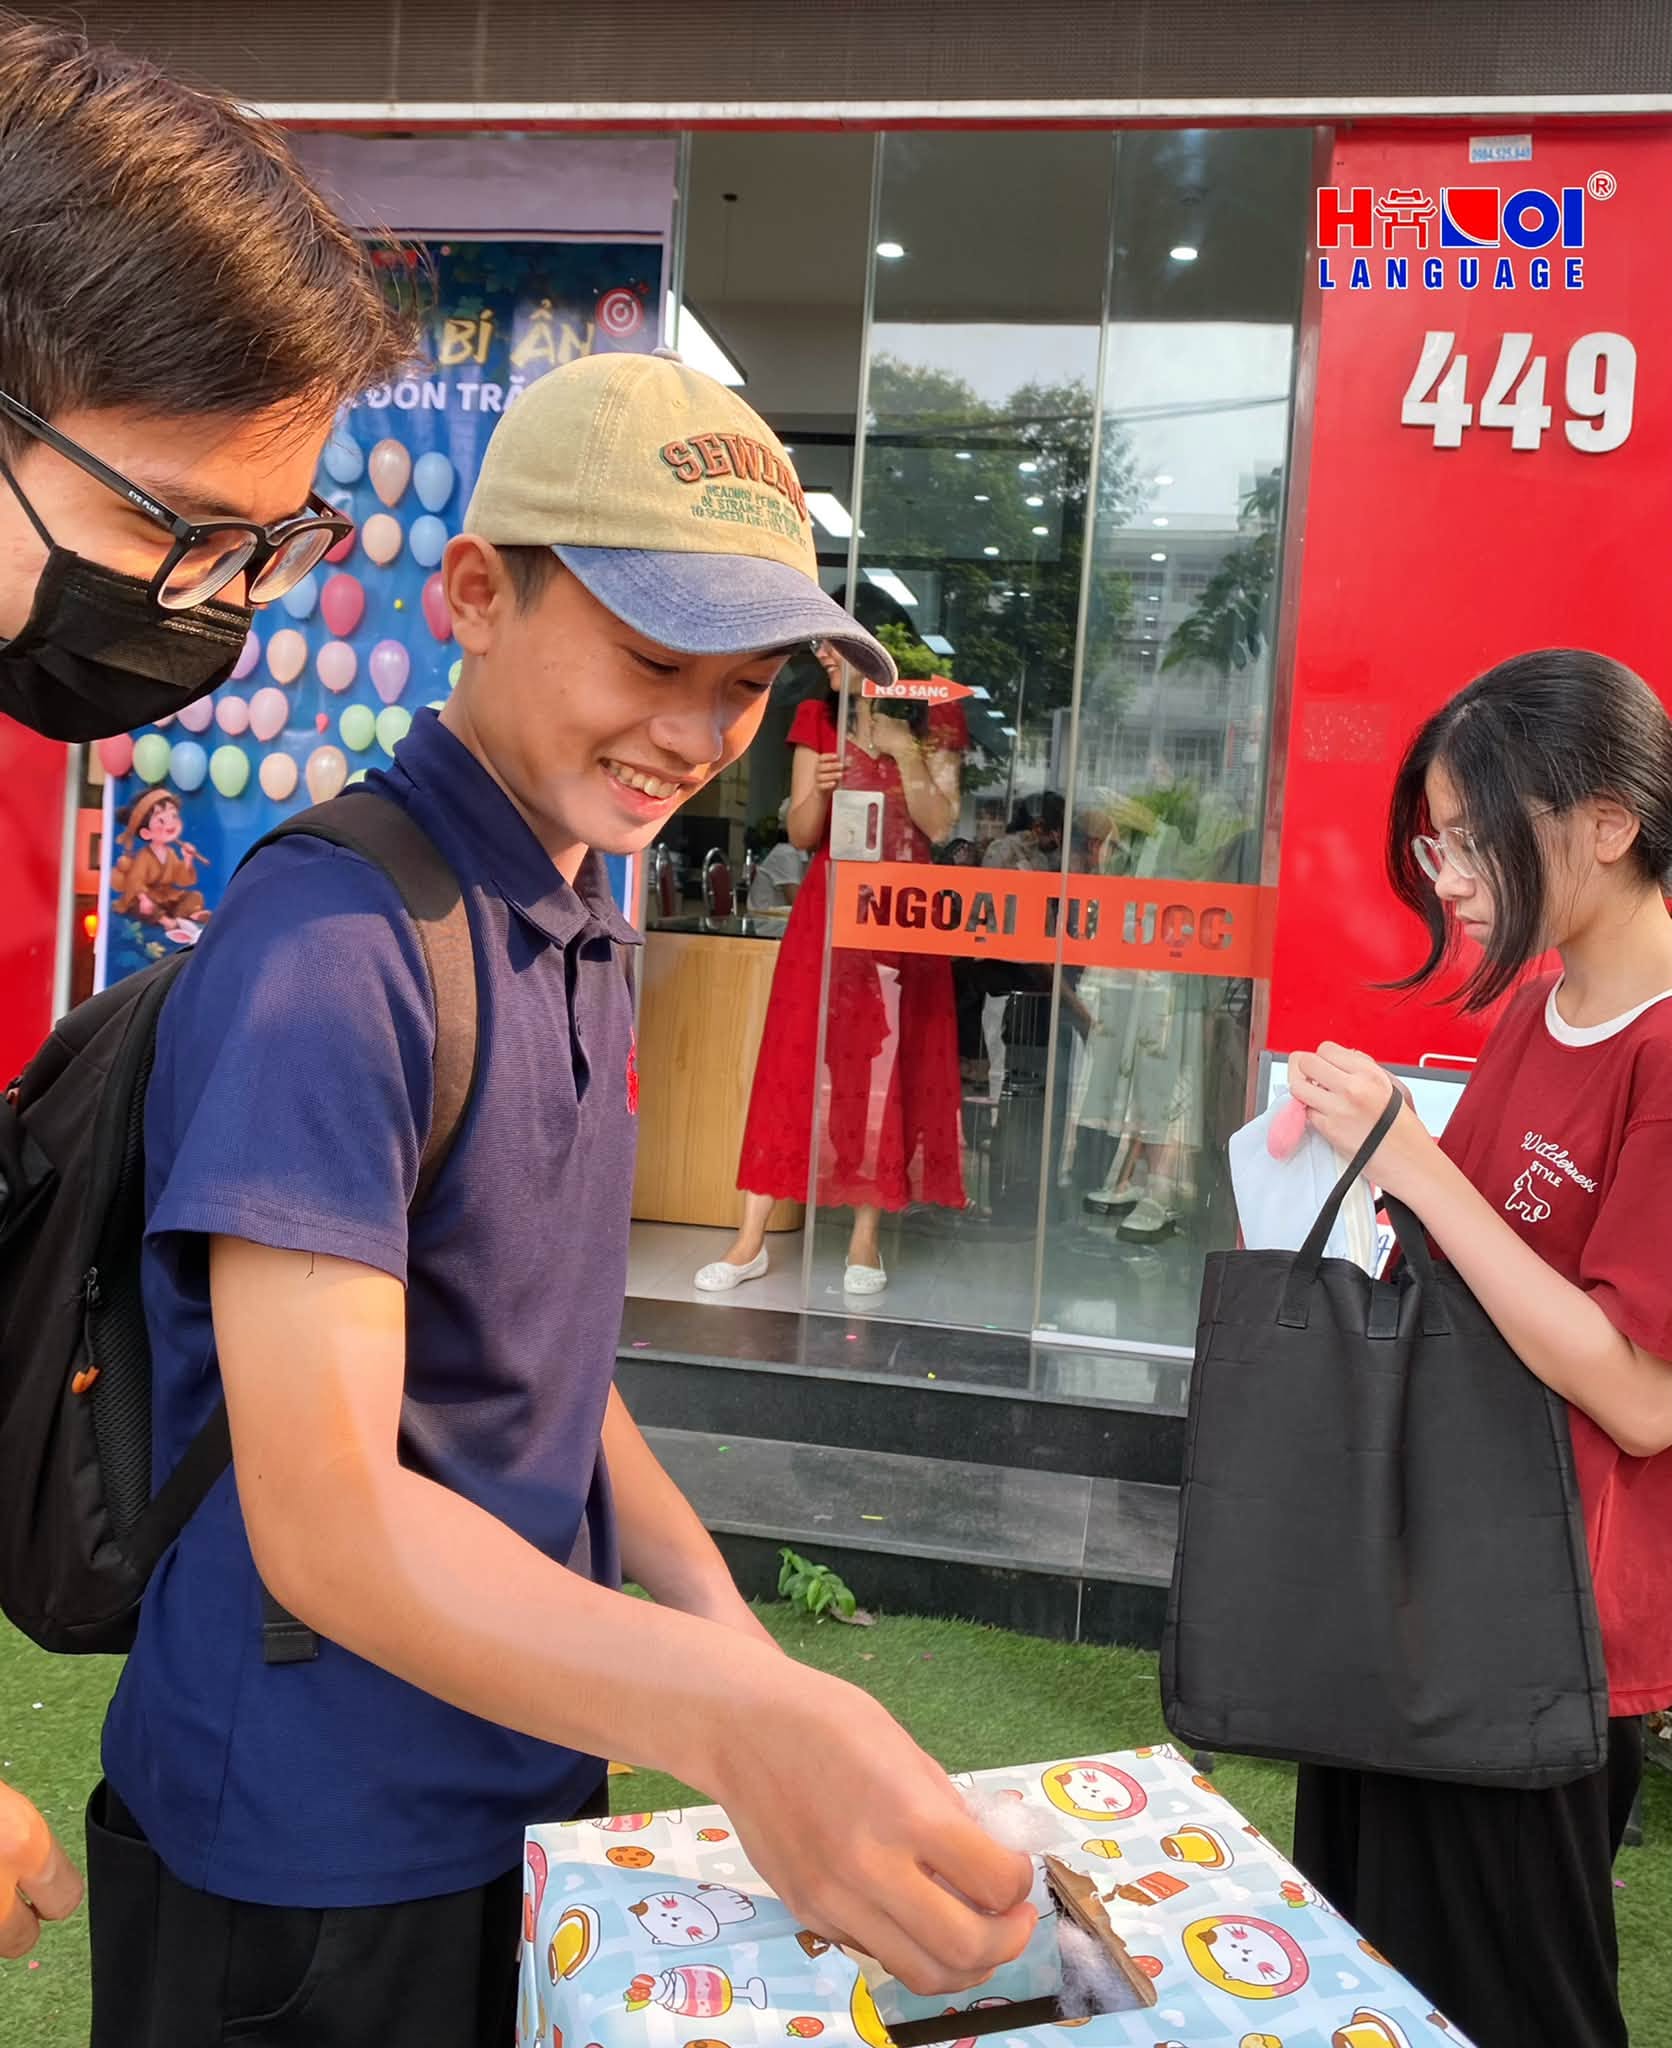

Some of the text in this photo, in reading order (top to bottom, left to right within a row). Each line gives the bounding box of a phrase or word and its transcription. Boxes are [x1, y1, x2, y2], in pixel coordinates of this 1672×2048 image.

[438, 309, 494, 365] BÍ
[456, 375, 527, 412] TRĂ
[1401, 331, 1638, 454] 449
[909, 686, 949, 698] SANG
[856, 884, 1017, 943] NGOẠI
[1530, 1160, 1563, 1188] STYLE
